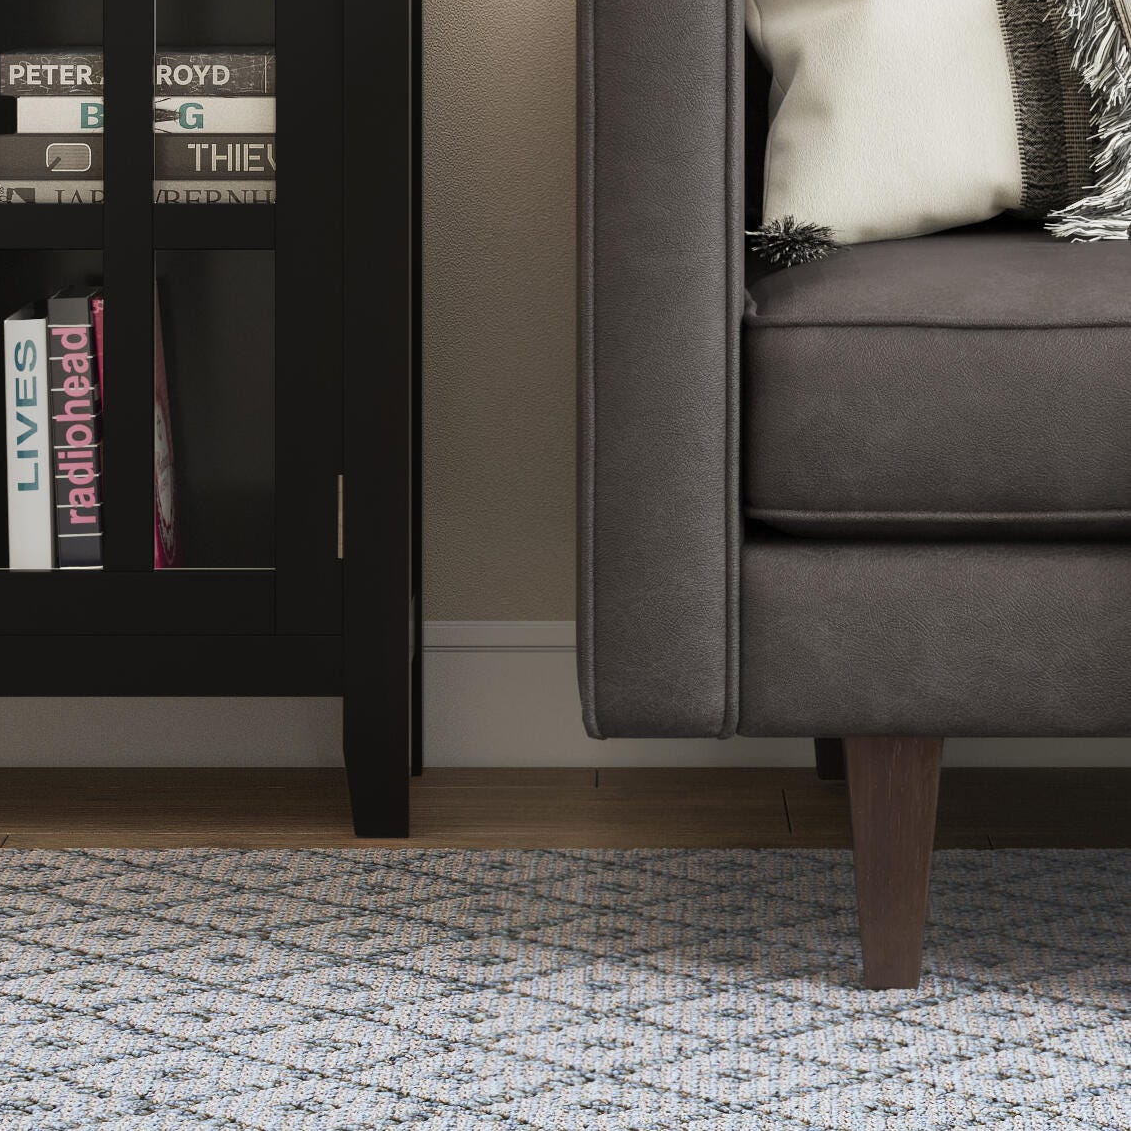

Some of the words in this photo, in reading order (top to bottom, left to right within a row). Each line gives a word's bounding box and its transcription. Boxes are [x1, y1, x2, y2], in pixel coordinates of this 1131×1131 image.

[9, 64, 93, 85] PETER
[156, 64, 230, 86] ROYD
[14, 338, 40, 491] LIVES
[51, 327, 97, 525] radiohead
